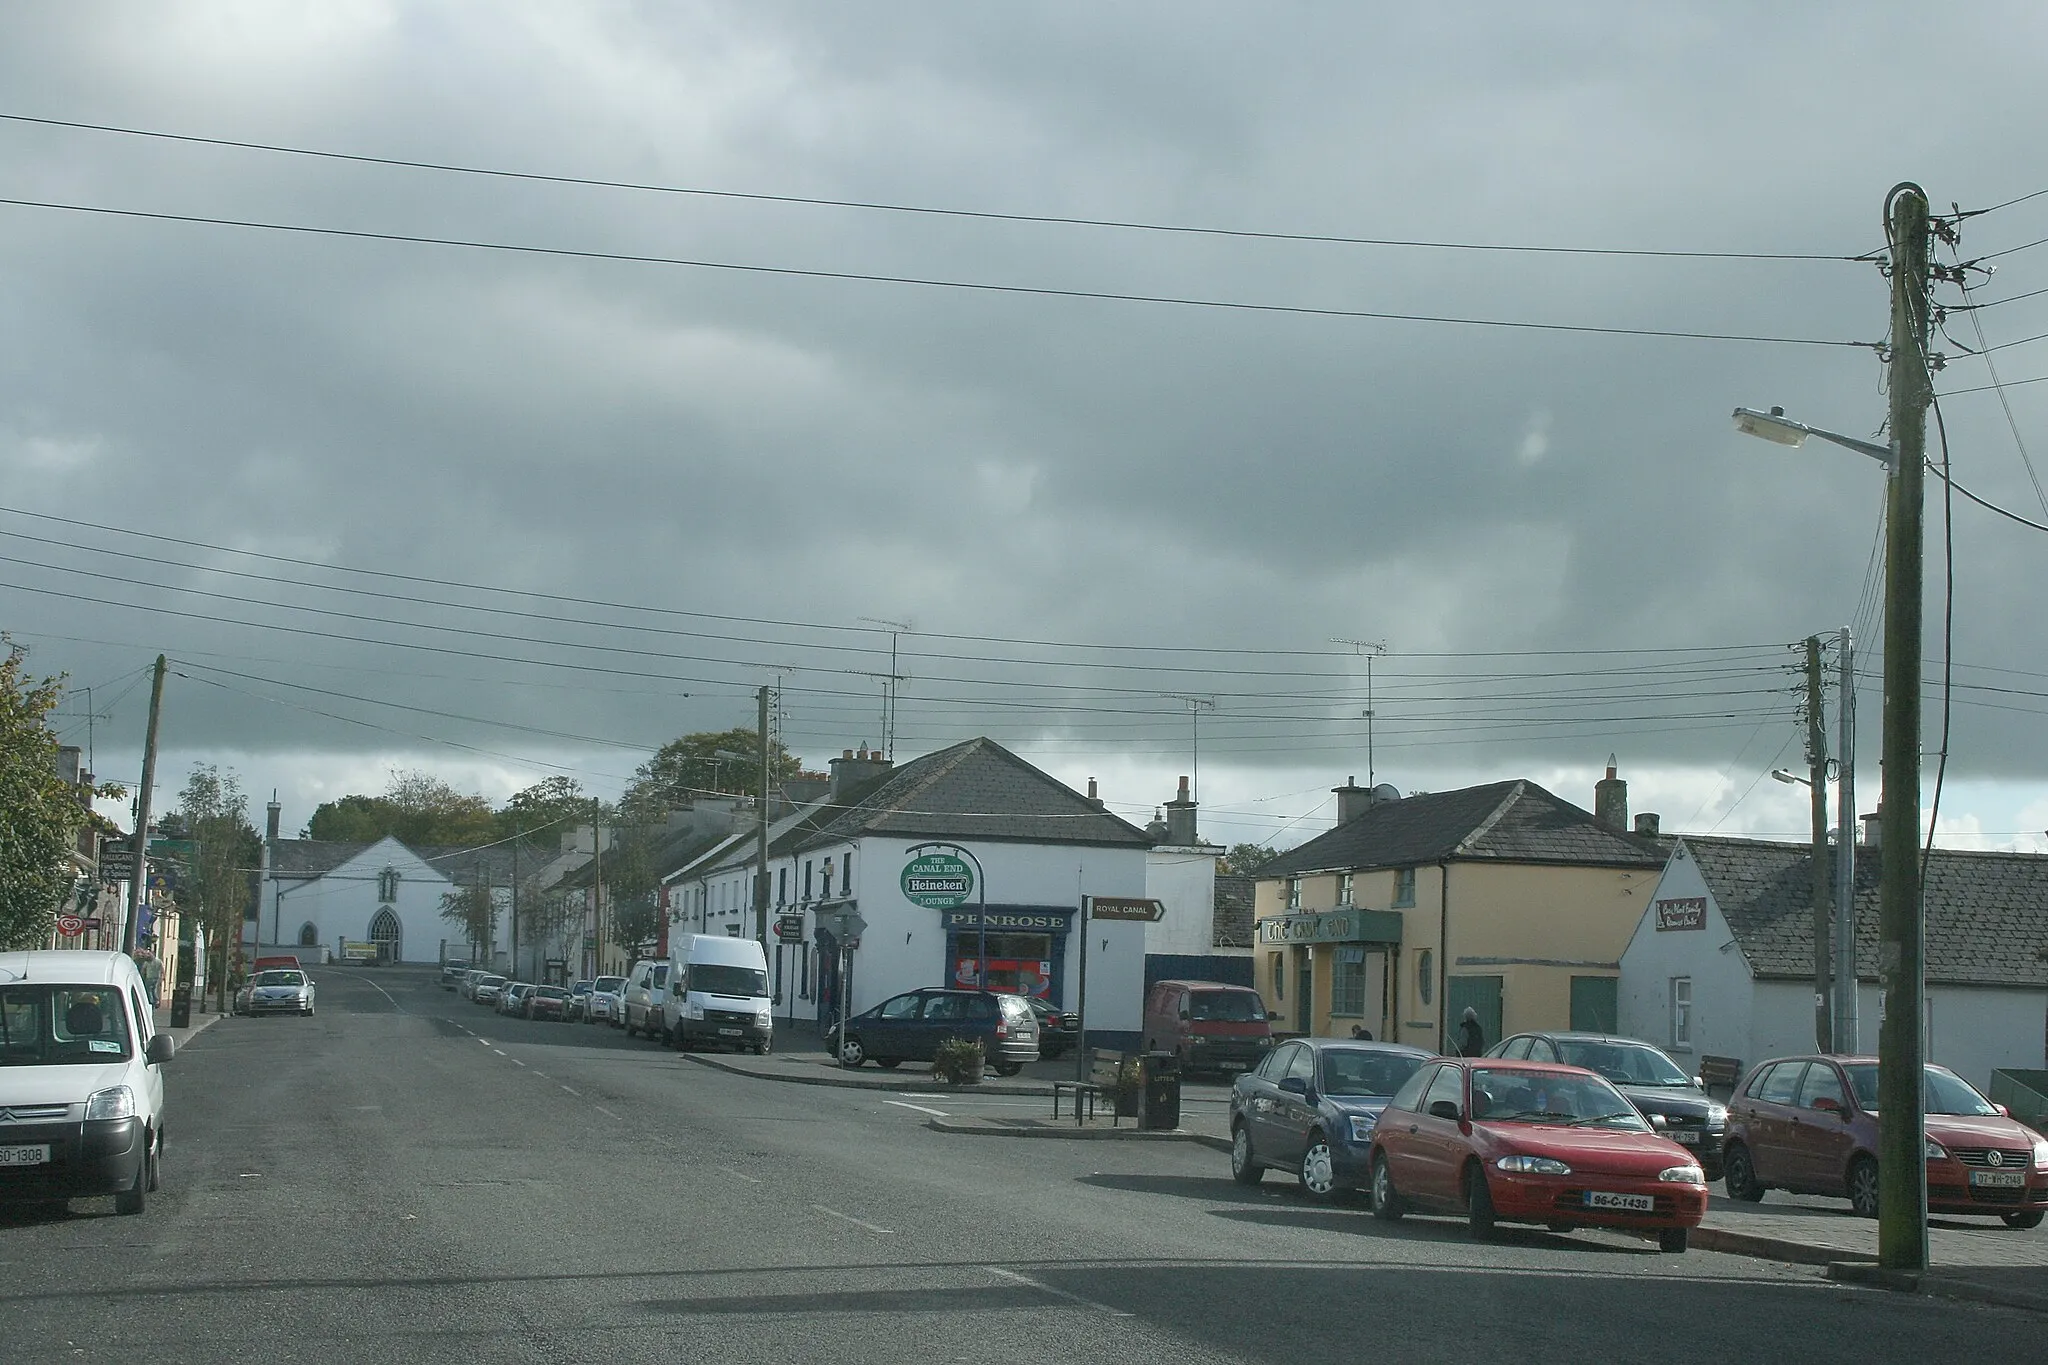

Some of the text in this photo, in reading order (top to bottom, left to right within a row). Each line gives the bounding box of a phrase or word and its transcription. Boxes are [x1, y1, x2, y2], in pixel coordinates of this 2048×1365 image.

[911, 880, 964, 891] Heineken
[1096, 905, 1148, 914] ROYAL CANAL
[951, 914, 1065, 928] PENROSE
